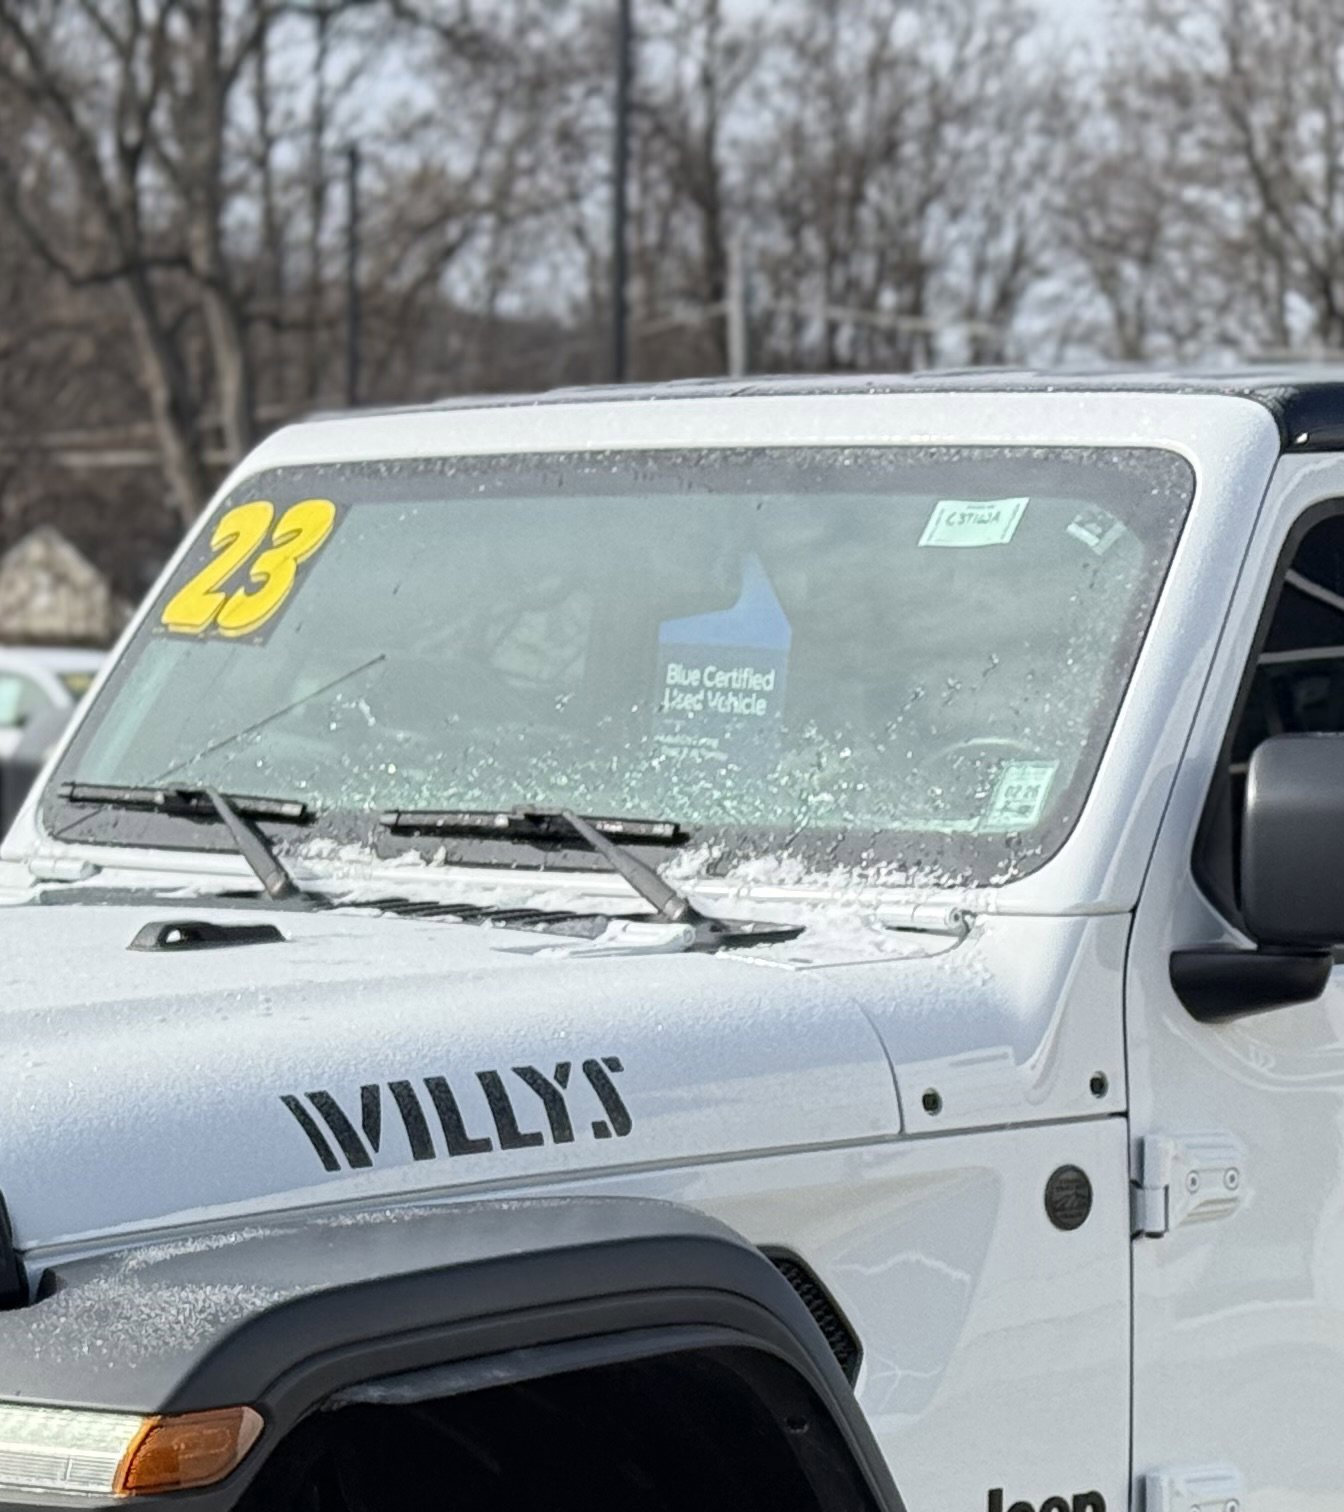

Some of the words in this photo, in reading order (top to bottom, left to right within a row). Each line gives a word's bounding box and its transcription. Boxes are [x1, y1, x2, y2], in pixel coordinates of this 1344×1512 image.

[161, 498, 336, 637] 23
[663, 687, 705, 712] Used
[707, 690, 768, 716] Vehicle
[666, 663, 701, 687] Blue
[703, 665, 775, 692] Certified
[280, 1055, 633, 1172] WILLYS
